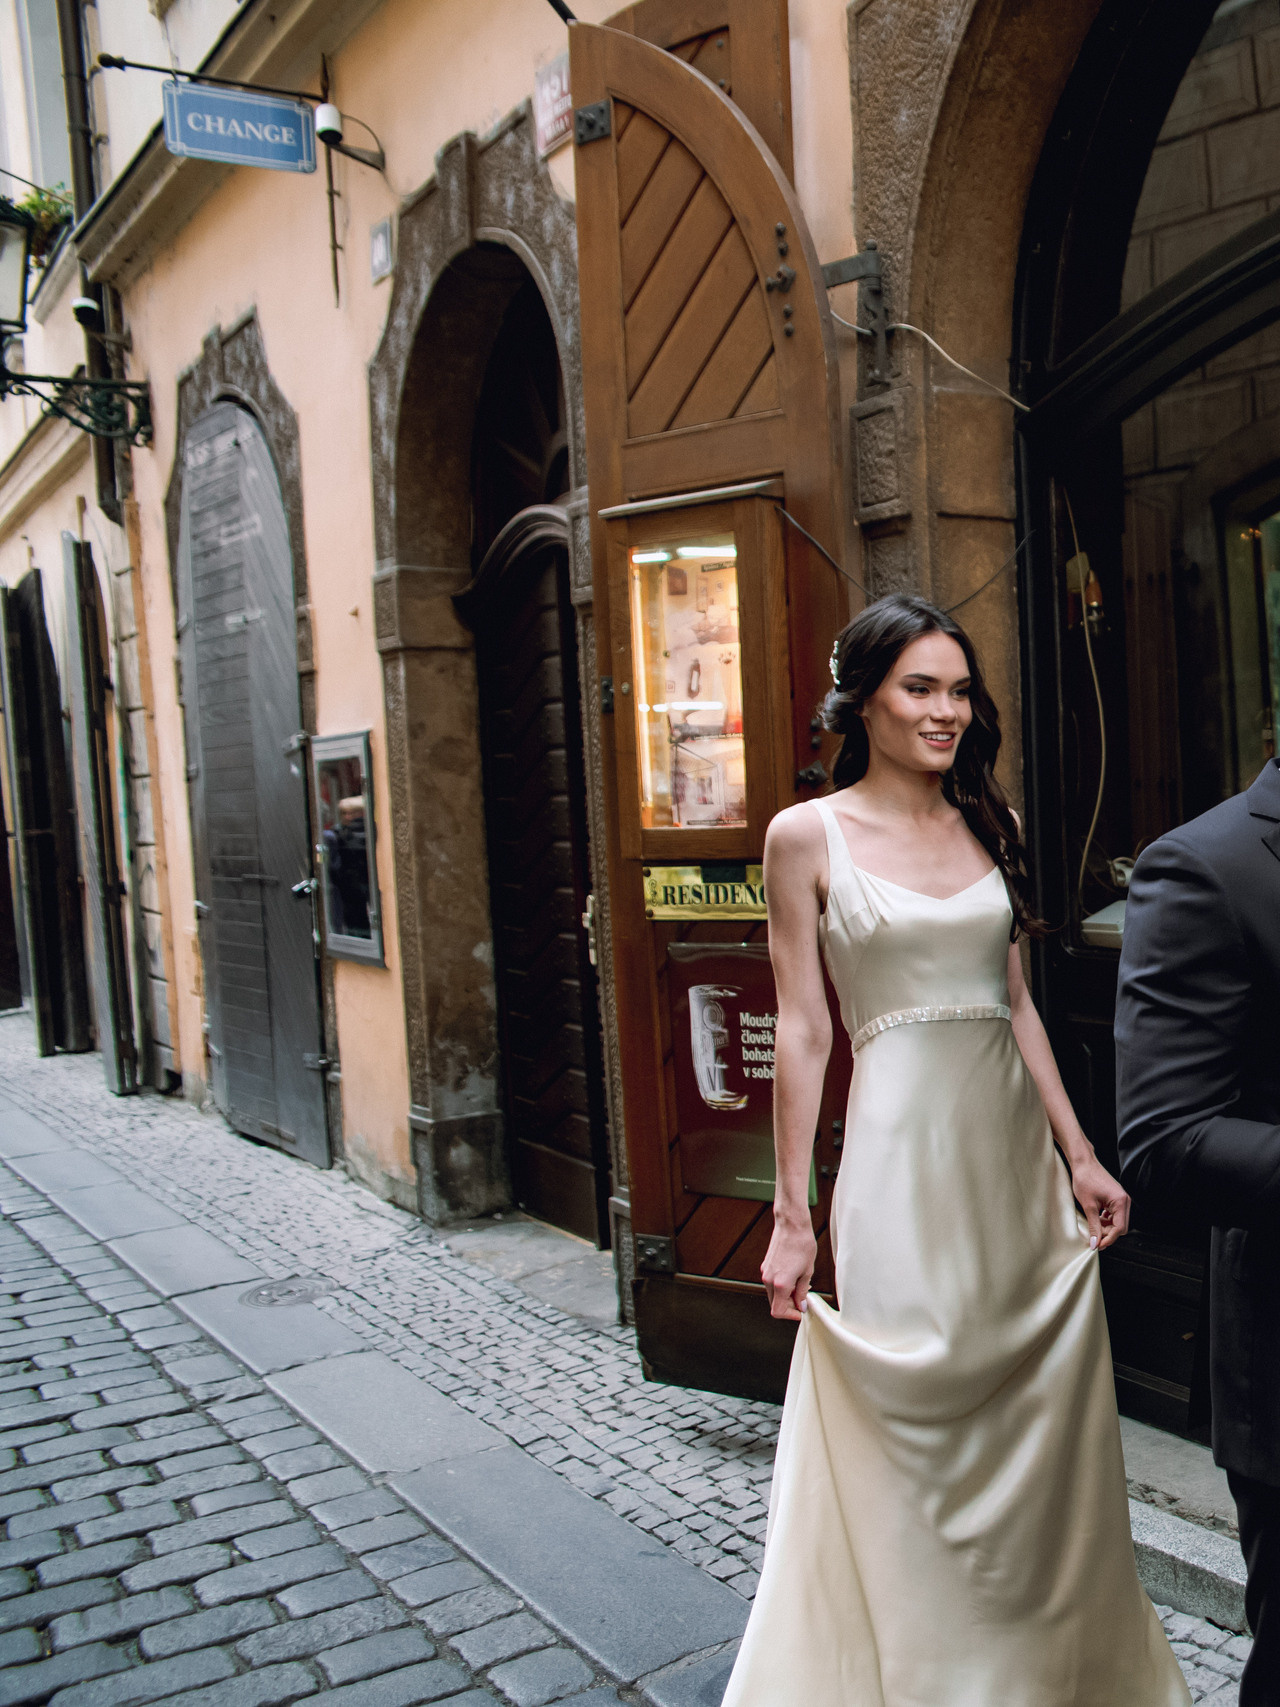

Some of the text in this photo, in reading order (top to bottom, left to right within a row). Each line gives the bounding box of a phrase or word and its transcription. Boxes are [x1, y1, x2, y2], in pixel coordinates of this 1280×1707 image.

[187, 112, 297, 146] CHANGE
[741, 1029, 775, 1044] člověk
[743, 1064, 776, 1079] v sobě
